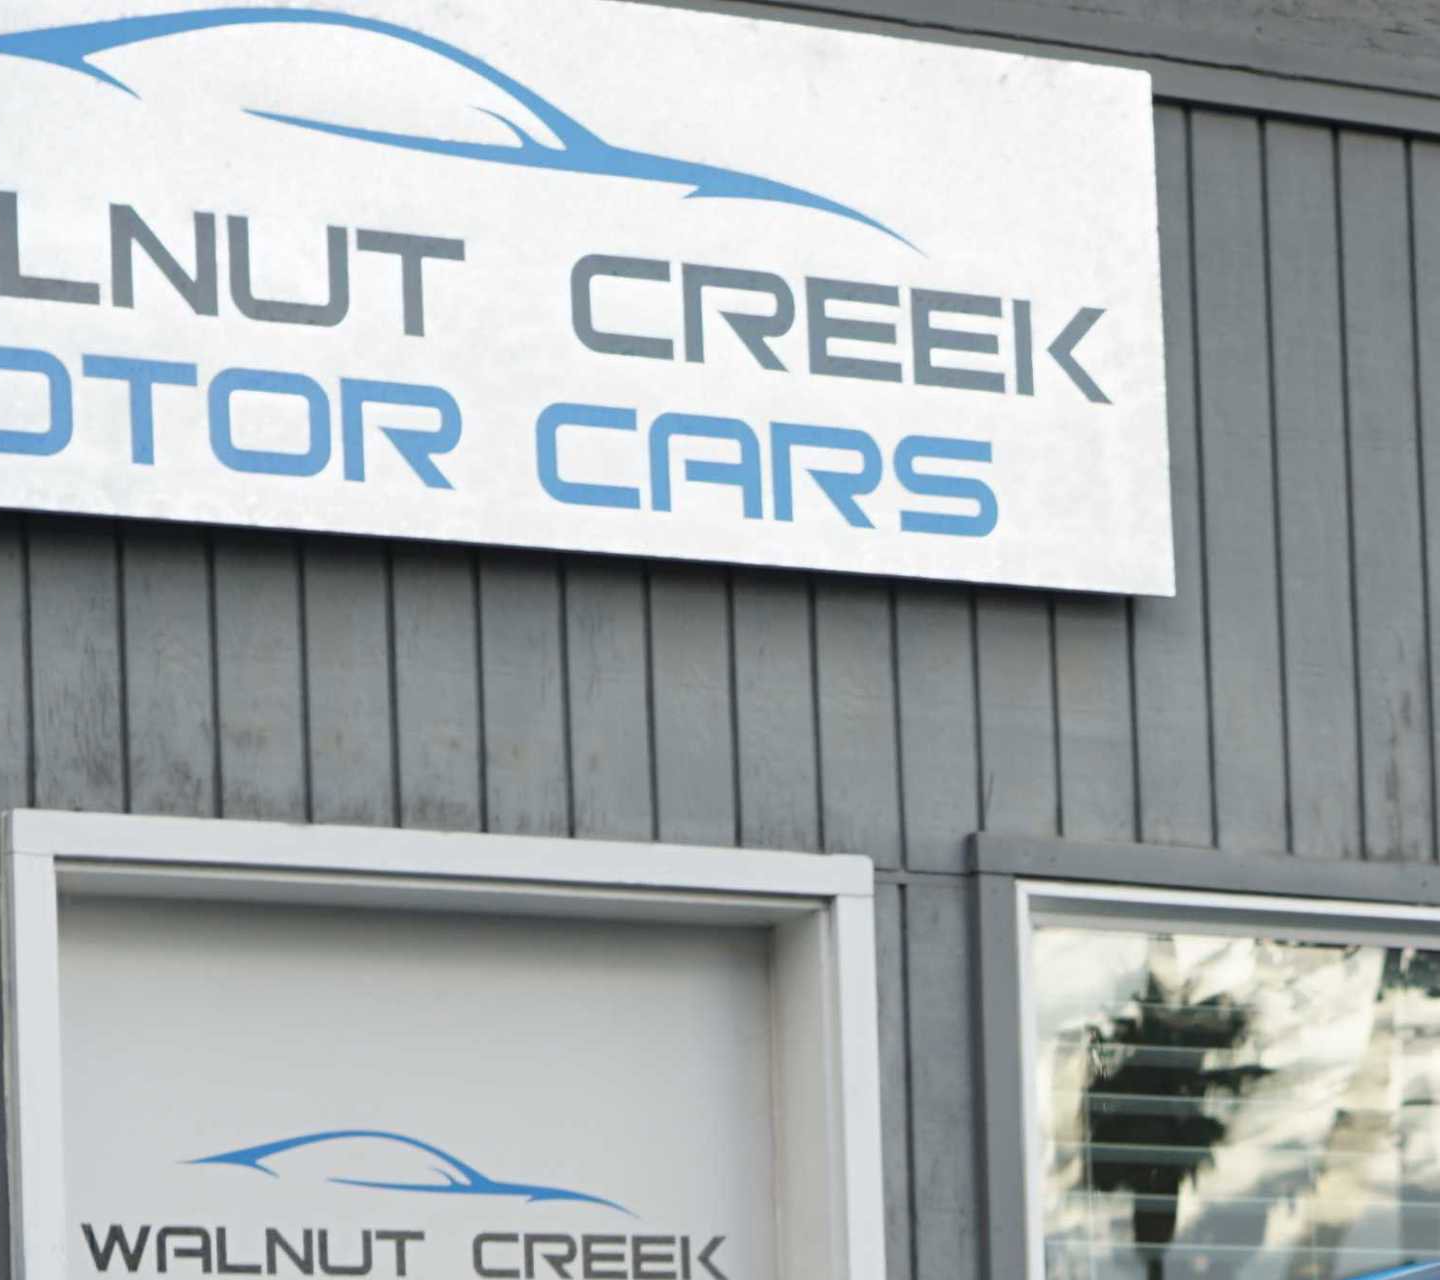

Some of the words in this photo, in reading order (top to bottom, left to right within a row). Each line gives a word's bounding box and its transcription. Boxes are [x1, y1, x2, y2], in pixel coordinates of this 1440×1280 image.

[571, 253, 1114, 405] CREEK
[536, 402, 999, 538] CARS
[80, 1222, 426, 1278] WALNUT
